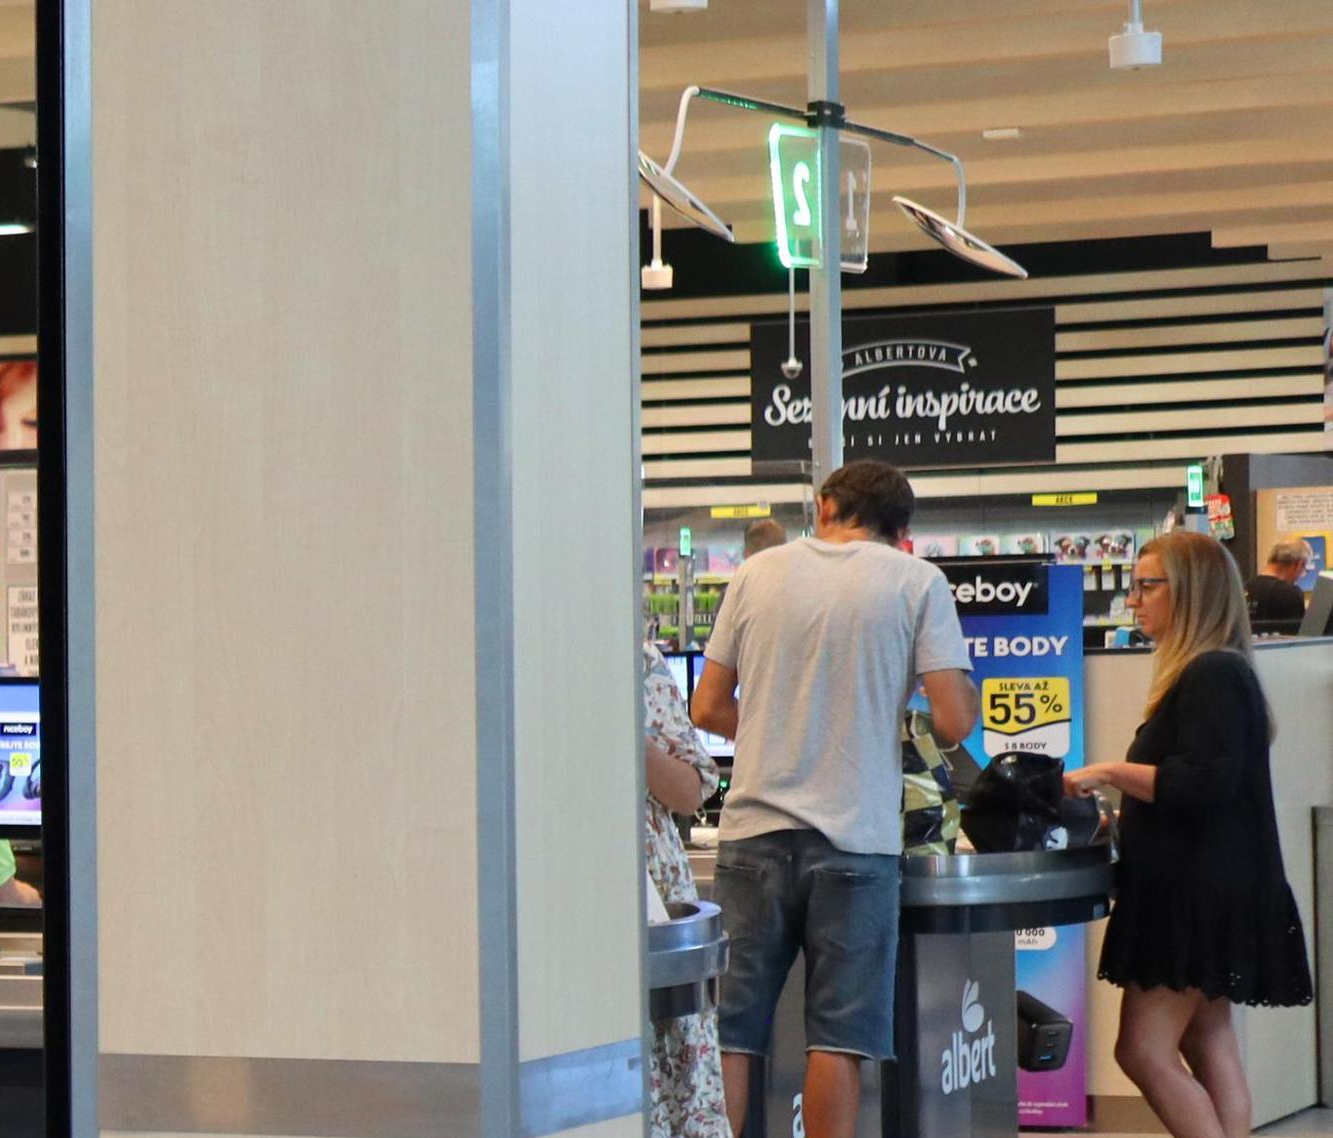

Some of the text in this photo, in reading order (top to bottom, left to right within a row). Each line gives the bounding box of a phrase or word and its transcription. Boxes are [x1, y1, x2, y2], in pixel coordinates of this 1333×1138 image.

[854, 345, 947, 366] ALBERTOVA
[764, 382, 1041, 431] Seznní inspirace
[895, 433, 921, 446] JEN
[934, 430, 997, 444] VYBRAT
[950, 576, 1033, 607] eboy
[994, 636, 1068, 657] BODY
[999, 680, 1049, 691] SLEVA AŽ
[989, 693, 1062, 725] 55%
[942, 1018, 996, 1094] albert
